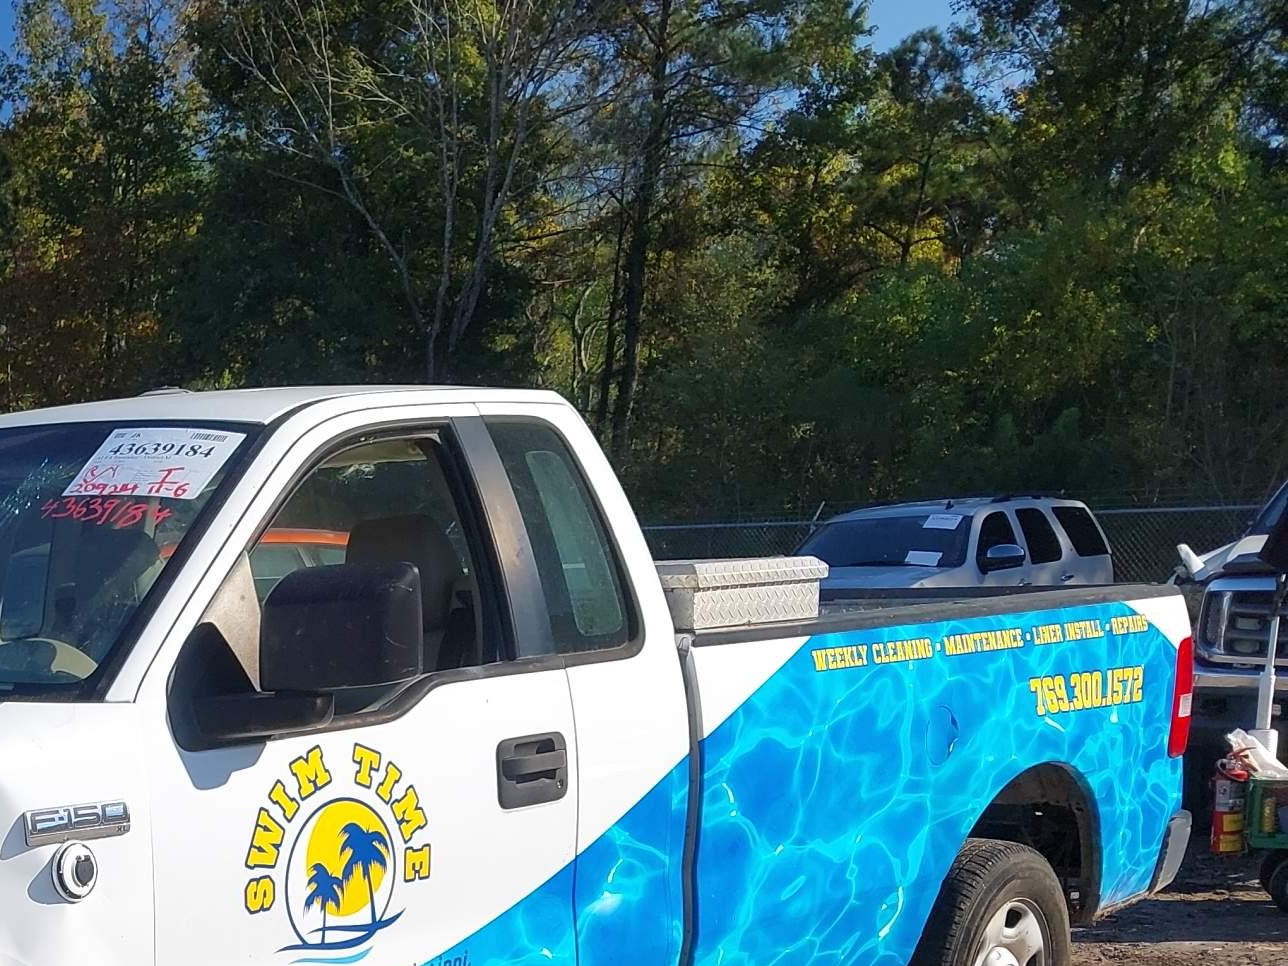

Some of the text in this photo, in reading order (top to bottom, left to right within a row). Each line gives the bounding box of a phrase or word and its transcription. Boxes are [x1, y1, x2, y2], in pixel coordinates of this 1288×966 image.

[110, 442, 216, 458] 43639184
[40, 497, 174, 527] 43639184
[812, 614, 1149, 671] WEEKLY CLEANING MAINTENANCE LINER INSTALL REPAIRS
[1029, 666, 1144, 716] 769.300.1572
[245, 743, 431, 914] SWIM TIME
